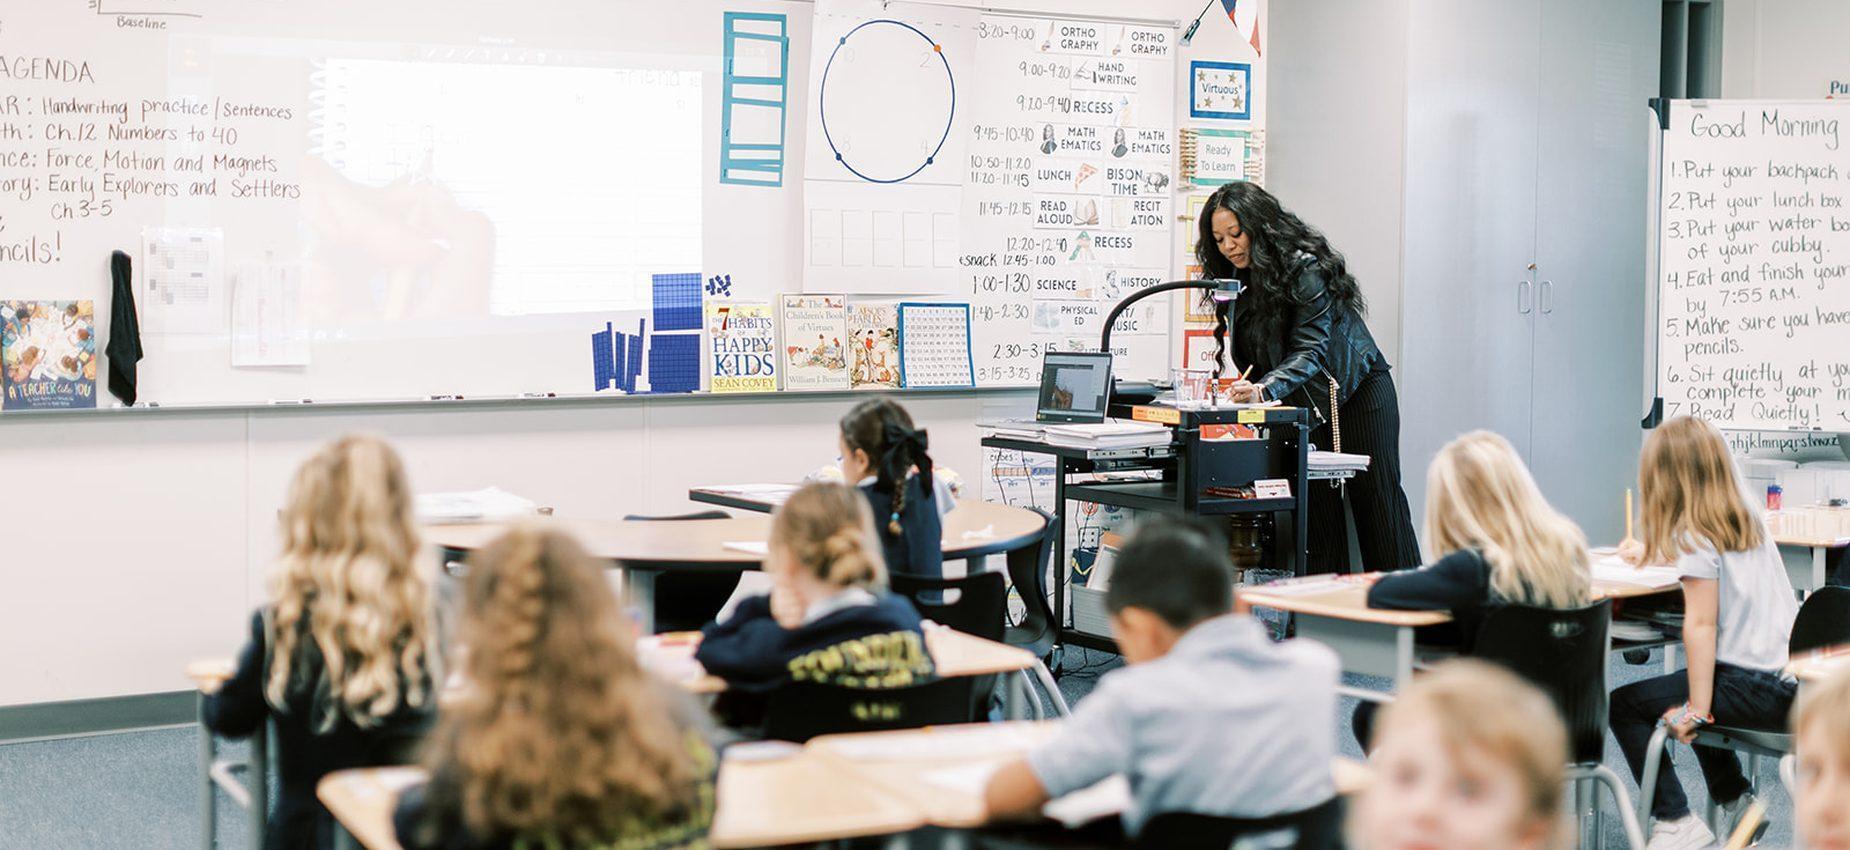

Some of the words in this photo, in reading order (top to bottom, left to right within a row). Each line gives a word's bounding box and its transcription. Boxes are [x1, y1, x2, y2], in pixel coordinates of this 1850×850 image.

[116, 16, 167, 30] Baseline
[1061, 26, 1096, 38] ORTHO
[1131, 31, 1165, 43] ORTHO
[1060, 38, 1099, 51] GRAPHY
[1131, 43, 1168, 55] GRAPHY
[0, 56, 95, 83] AGENDA
[1098, 61, 1125, 73] HAND
[1097, 74, 1138, 86] WRITING
[1202, 82, 1239, 95] Virtuous
[42, 96, 128, 124] Handwriting
[1073, 100, 1114, 114] RECESS
[108, 124, 178, 142] Numbers
[187, 125, 205, 142] to
[212, 127, 238, 146] 40
[1067, 126, 1096, 138] MATH
[1137, 130, 1165, 141] MATH
[1691, 110, 1746, 138] Good
[1761, 108, 1840, 151] Morning
[1060, 139, 1101, 151] EMATICS
[1131, 142, 1171, 154] EMATICS
[1205, 143, 1232, 156] Ready
[103, 150, 166, 172] Motion
[173, 154, 203, 172] and
[213, 154, 279, 178] Magnets
[1200, 160, 1211, 171] To
[1212, 160, 1236, 172] Learn
[1037, 169, 1072, 182] LUNCH
[1106, 168, 1143, 181] BISON
[1722, 166, 1758, 188] your
[1767, 159, 1839, 185] backpack
[48, 173, 96, 201] Early
[103, 173, 179, 199] Explorers
[188, 177, 217, 197] and
[230, 180, 302, 199] Settlers
[1111, 182, 1138, 196] TIME
[1040, 200, 1067, 212] READ
[1133, 201, 1162, 212] RECIT
[1726, 195, 1763, 217] your
[1773, 191, 1815, 208] lunch
[1820, 193, 1842, 208] box
[1037, 213, 1073, 225] ALOUD
[1131, 214, 1164, 226] ATION
[1724, 219, 1760, 241] your
[1768, 213, 1822, 232] water
[1094, 236, 1133, 249] RECESS
[1687, 243, 1710, 260] of
[1718, 242, 1760, 264] your
[1771, 235, 1831, 264] cubby.
[1120, 276, 1162, 289] HISTORY
[1721, 264, 1750, 283] and
[1758, 263, 1805, 281] finish
[1813, 265, 1850, 290] your
[1036, 279, 1077, 290] SCIENCE
[1686, 297, 1707, 319] by
[1720, 287, 1763, 307] 7:55
[1060, 305, 1099, 316] PHYSICAL
[717, 307, 730, 331] 7
[728, 317, 773, 329] HABITS
[1073, 316, 1085, 326] ED
[1783, 313, 1810, 338] you
[1112, 320, 1139, 332] USIC
[713, 337, 773, 353] HAPPY
[1684, 336, 1745, 362] pencils.
[713, 353, 775, 377] KIDS
[1722, 362, 1783, 392] quietly
[1798, 359, 1819, 379] at
[713, 378, 741, 389] SEAN
[742, 377, 776, 389] COVEY
[8, 385, 17, 400] A
[17, 381, 57, 401] TEACHER
[74, 381, 92, 398] YOU
[1686, 383, 1767, 407] complete
[1785, 386, 1823, 404] your
[1689, 402, 1736, 422] Read
